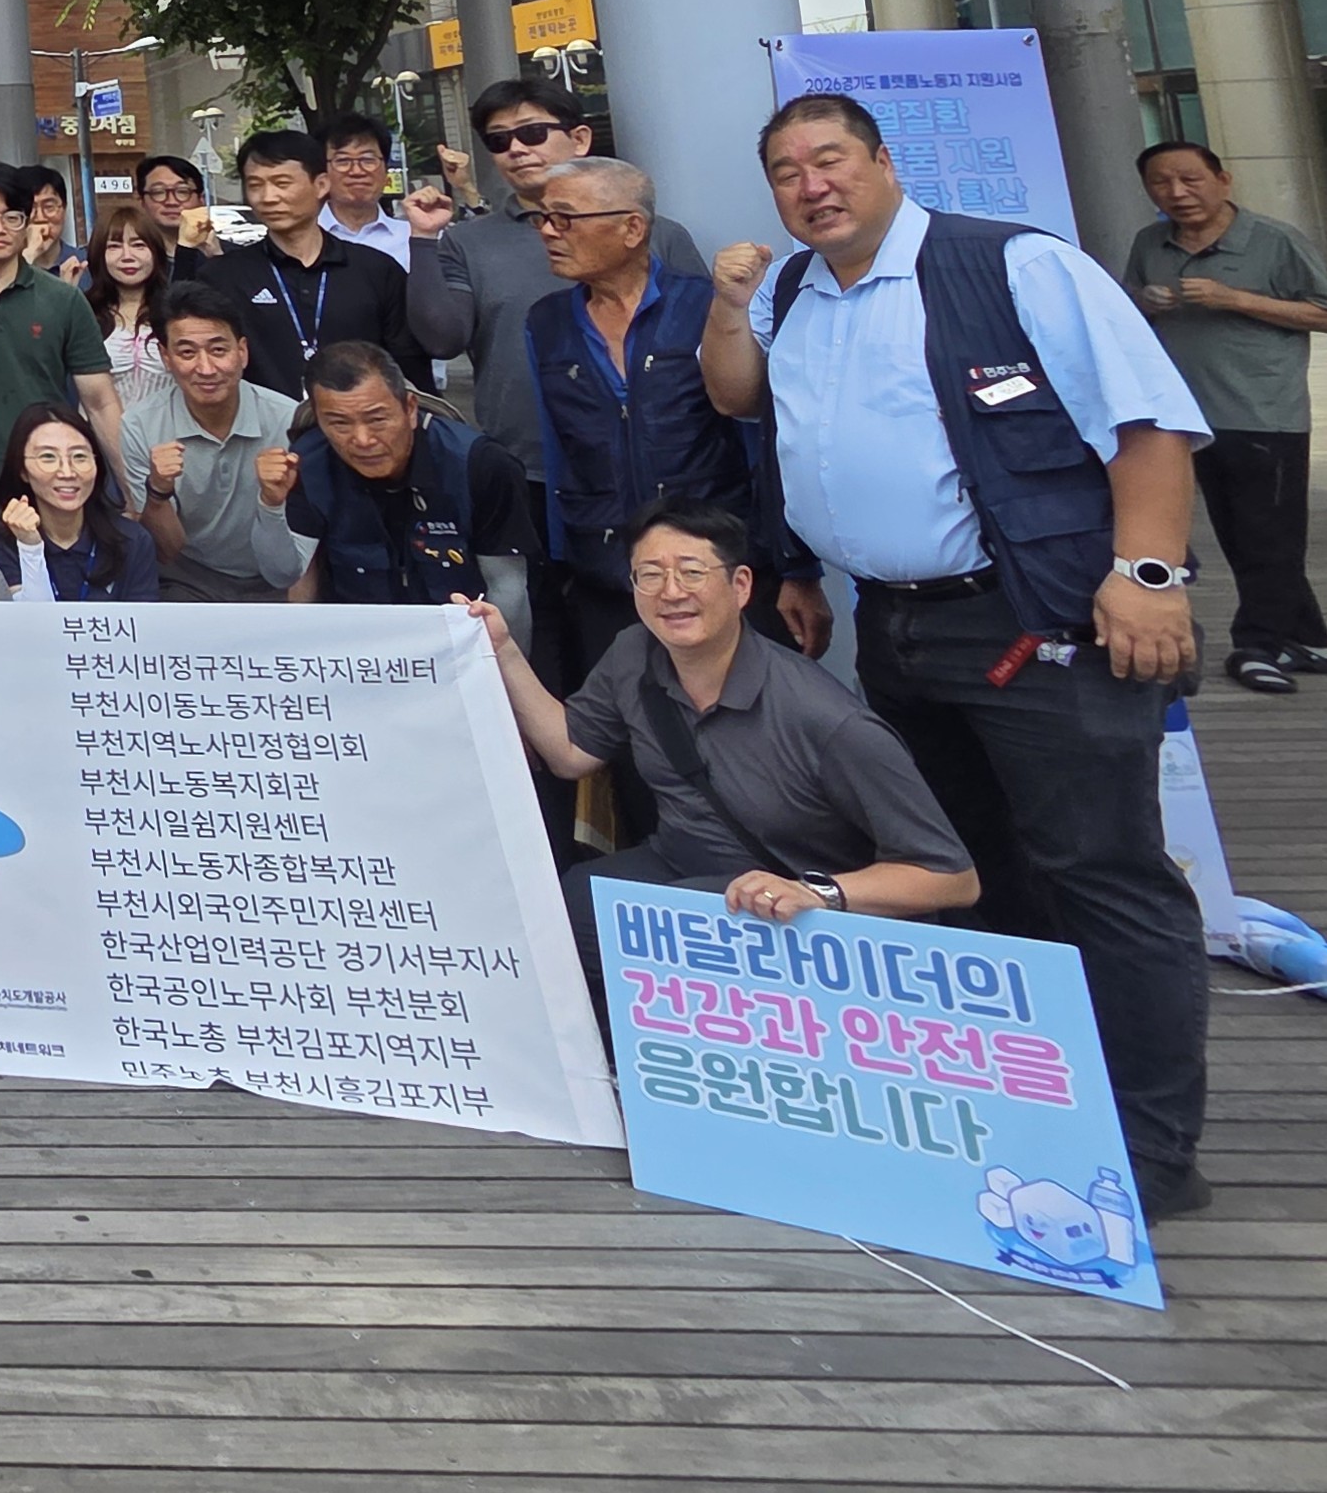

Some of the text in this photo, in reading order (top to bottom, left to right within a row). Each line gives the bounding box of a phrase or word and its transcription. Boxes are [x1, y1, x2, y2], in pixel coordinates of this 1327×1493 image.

[967, 72, 1023, 88] 지원사업
[860, 97, 970, 136] 열질환
[948, 137, 1017, 175] 지원
[62, 616, 138, 643] 부천시
[65, 653, 438, 685] 부천시비정규직노동자지원센터
[70, 690, 333, 722] 부천시이동노동자쉼터
[75, 729, 369, 762] 부천지역노사민정협의회
[79, 768, 320, 802] 부천시노동복지회관
[84, 807, 330, 843] 부천시일쉼지원센터
[90, 847, 397, 887] 부천시노동자종합복지관
[96, 889, 439, 932] 부천시외국인주민지원센터
[100, 929, 521, 980] 한국산업인력공단 경기서부지사
[616, 902, 1032, 1025] 배달라이더의
[106, 972, 470, 1024] 한국공인노무사회 부천분회
[113, 1015, 482, 1071] 한국노총 부천김포지역지부
[623, 969, 1074, 1107] 건강과 안전을
[245, 1069, 495, 1118] 부천시흥김포지부
[638, 1040, 993, 1163] 응원합니다
